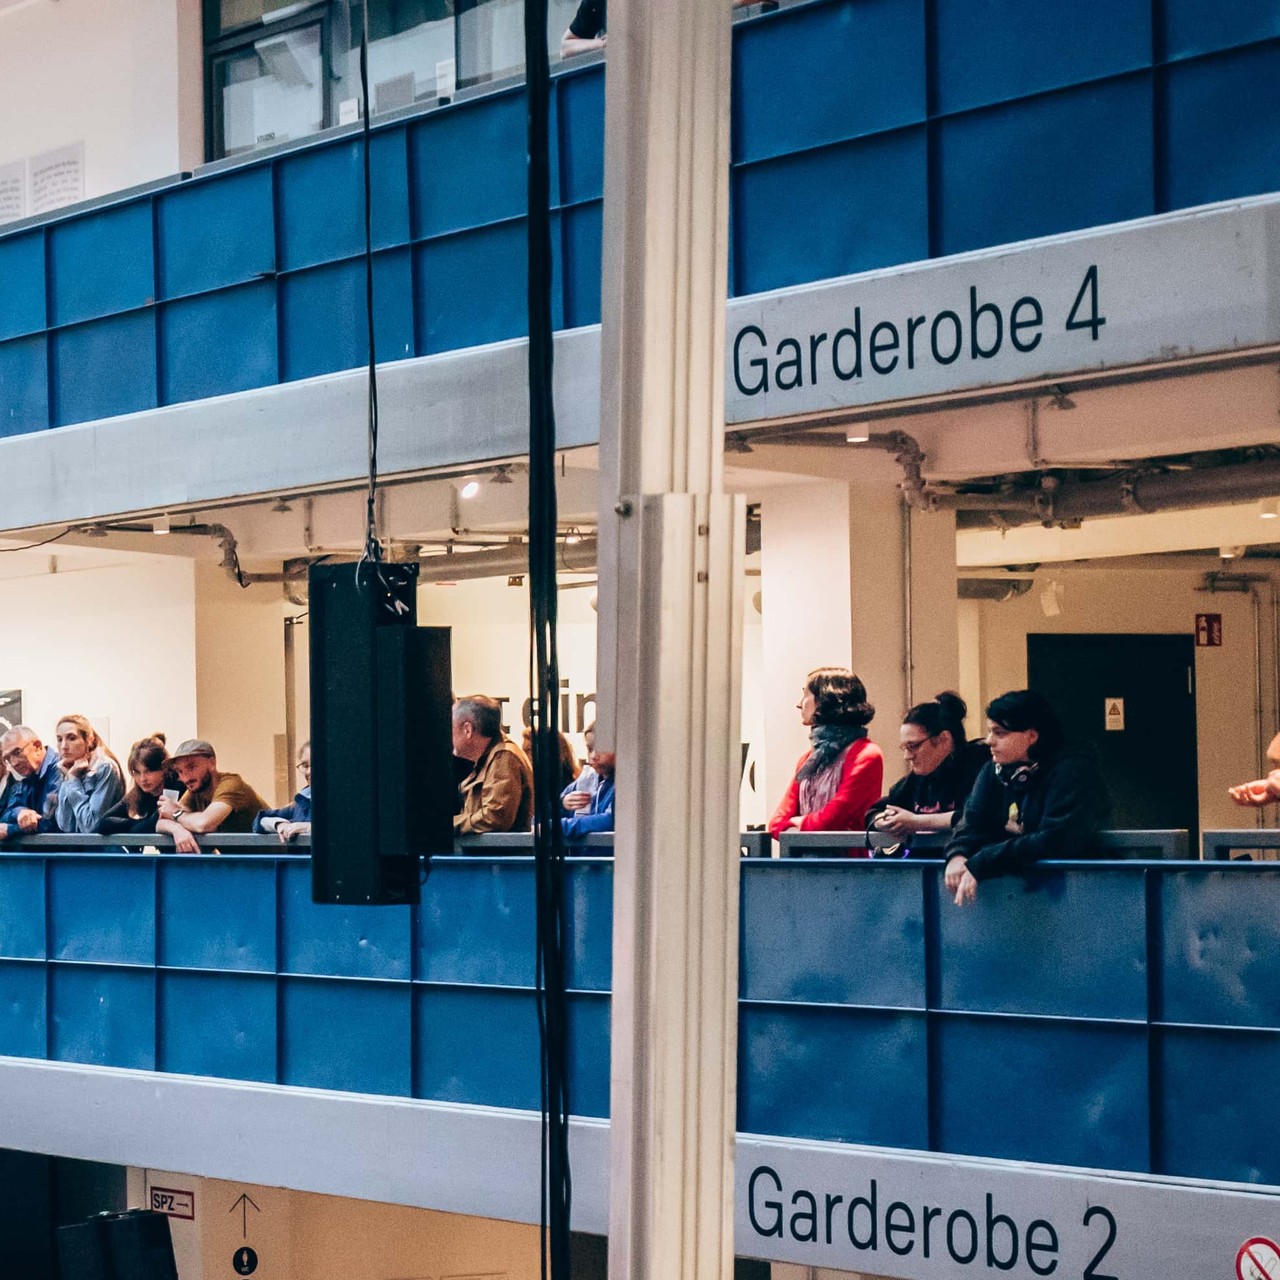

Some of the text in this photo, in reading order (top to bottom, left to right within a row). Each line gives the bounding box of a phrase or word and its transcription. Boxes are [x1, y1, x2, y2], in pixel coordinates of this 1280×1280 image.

[732, 264, 1107, 396] Garderobe 4
[153, 1193, 175, 1212] SPZ
[748, 1165, 1059, 1276] Garderobe
